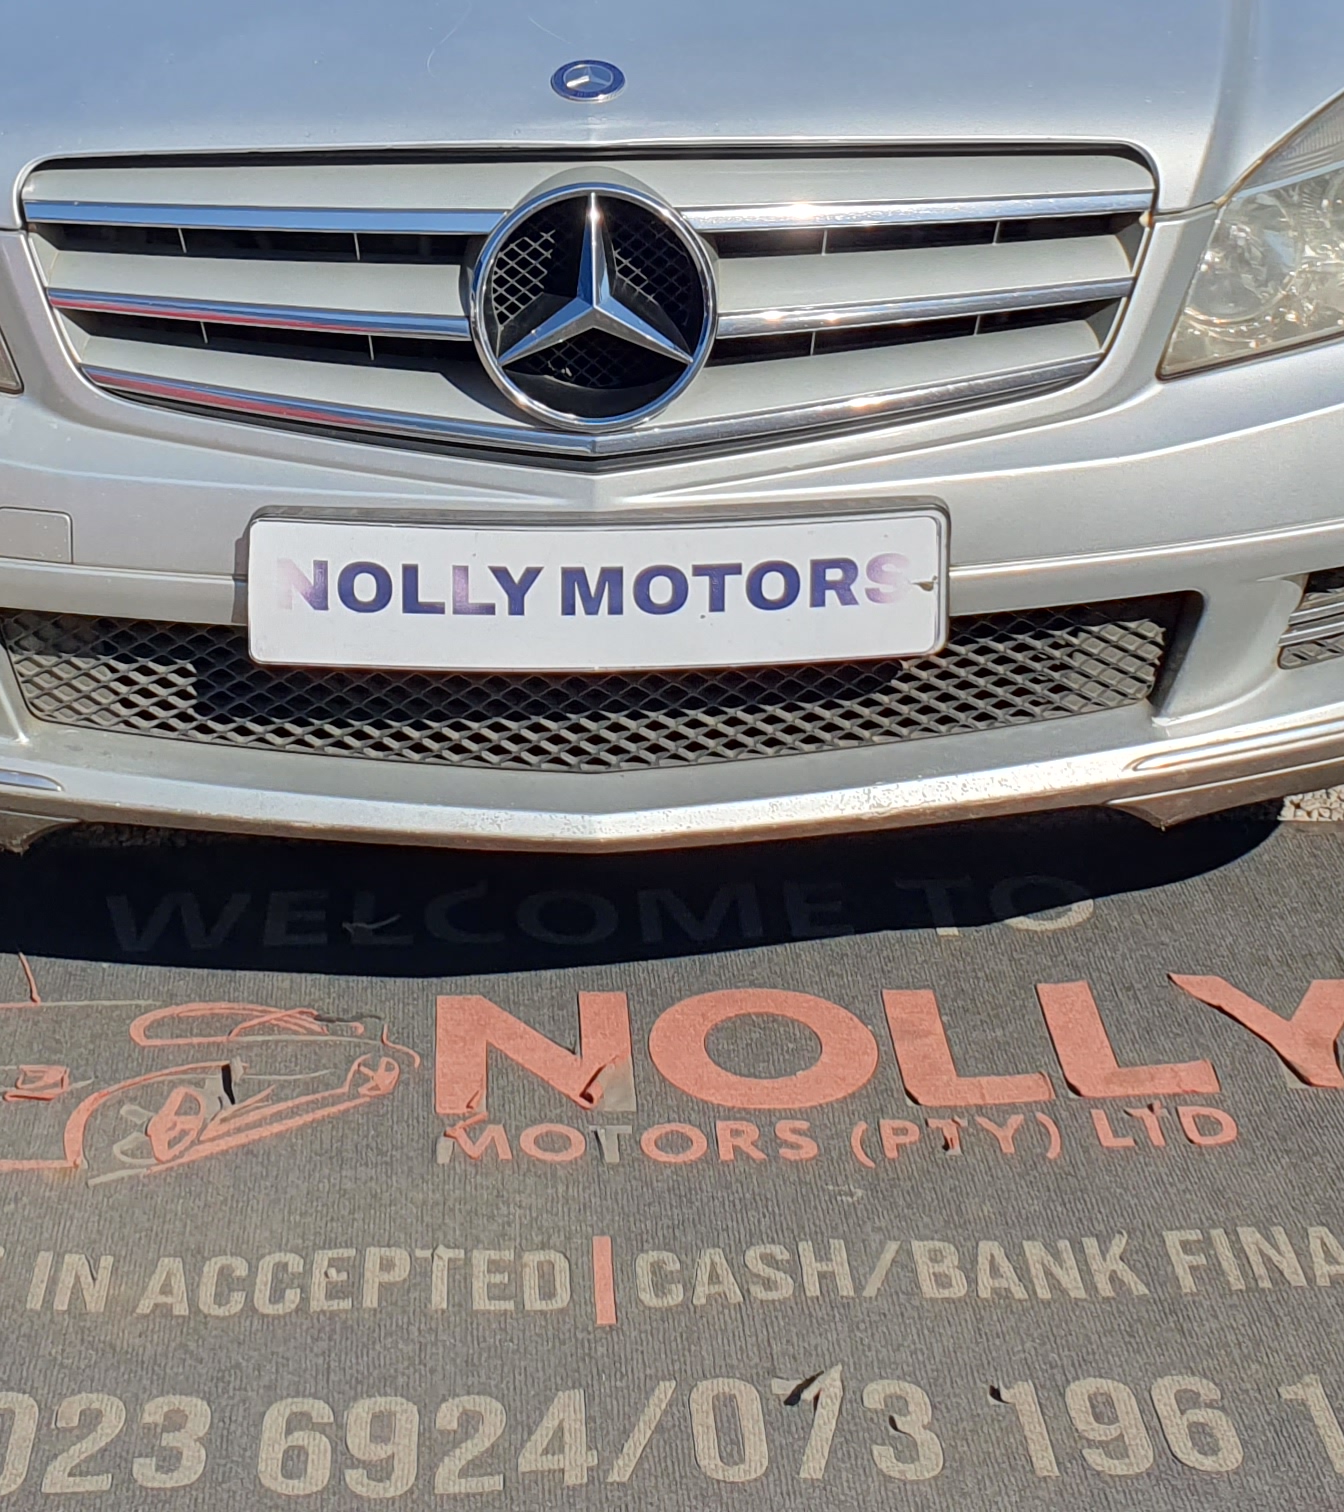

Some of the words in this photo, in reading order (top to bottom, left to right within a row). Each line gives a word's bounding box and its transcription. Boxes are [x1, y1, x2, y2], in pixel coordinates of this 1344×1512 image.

[277, 558, 544, 616] NOLLY
[561, 552, 912, 616] MOTORS
[107, 877, 856, 952] WELCOME
[894, 874, 1096, 936] TO
[436, 1113, 819, 1164] MOTORS
[851, 1113, 1061, 1168] (PTY)
[1093, 1100, 1238, 1150] LTD
[26, 1250, 114, 1313] IN
[136, 1245, 571, 1317] ACCEPTED
[634, 1231, 1148, 1307] CASH/BANK
[990, 1375, 1246, 1478] 196
